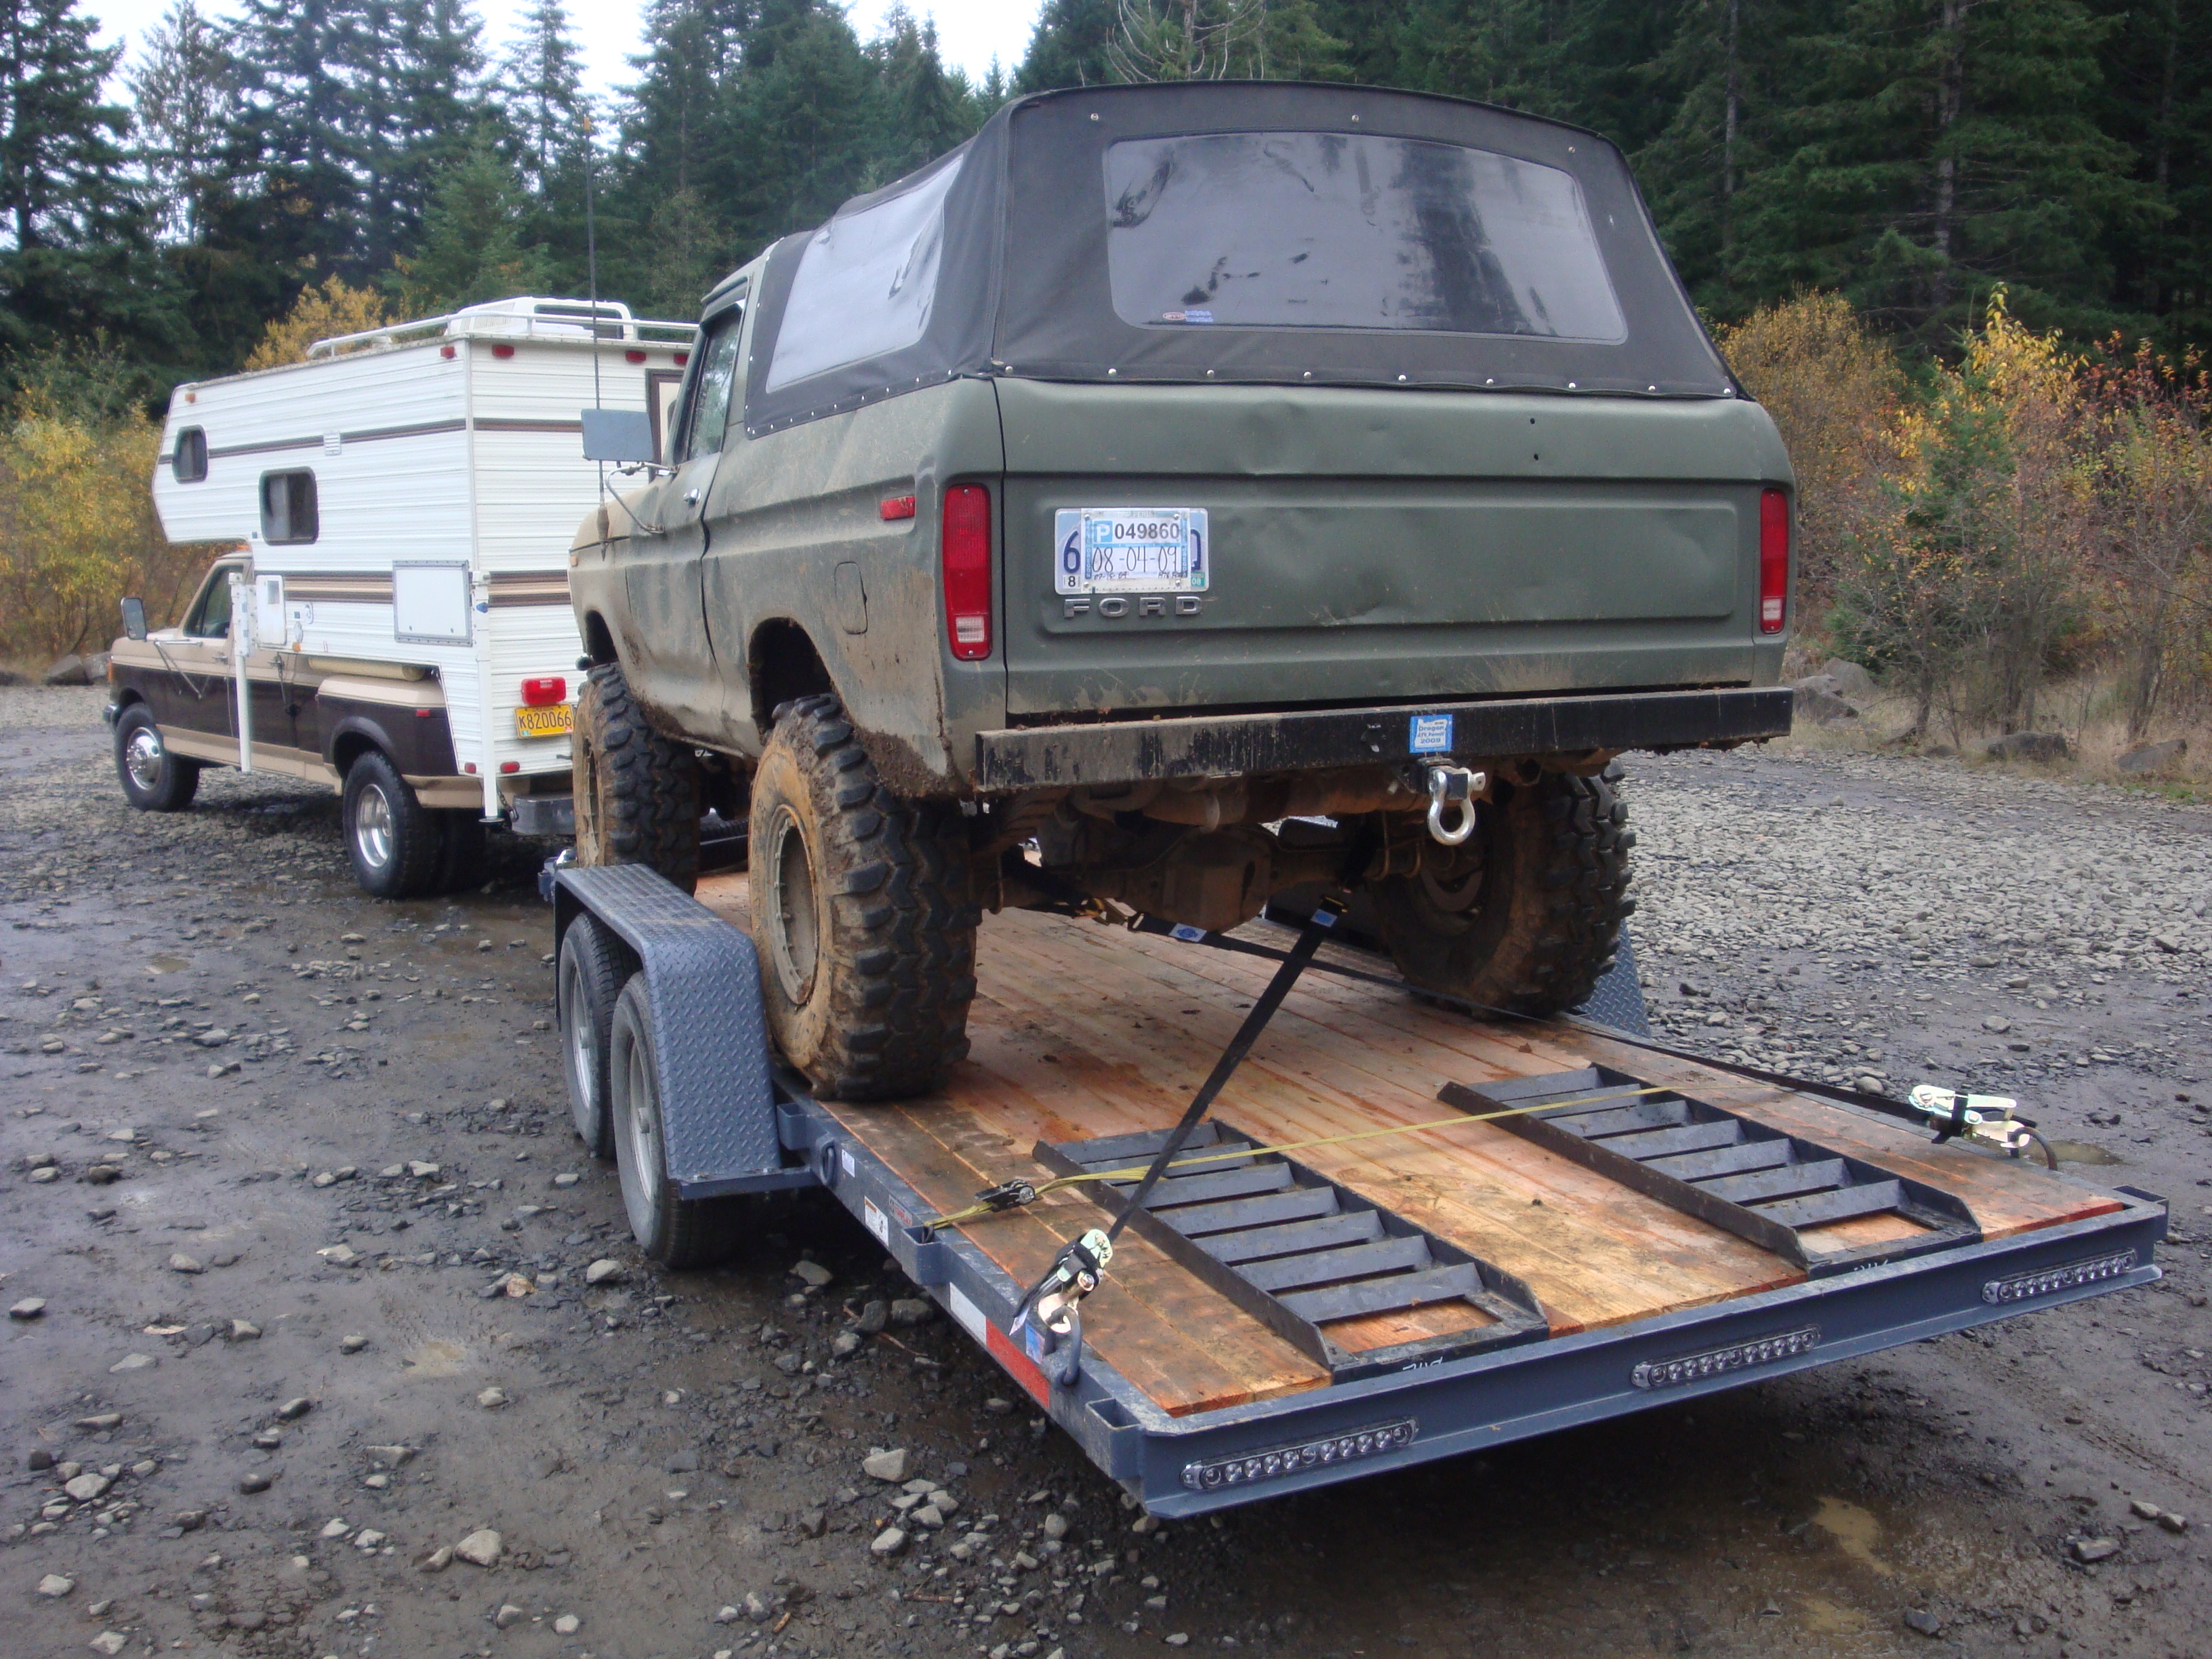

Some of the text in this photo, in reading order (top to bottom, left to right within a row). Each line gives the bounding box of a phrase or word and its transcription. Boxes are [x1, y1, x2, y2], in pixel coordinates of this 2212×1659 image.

[1114, 523, 1179, 540] 049860
[1068, 575, 1076, 587] 8
[1064, 596, 1203, 618] FORD
[518, 711, 572, 729] K820066
